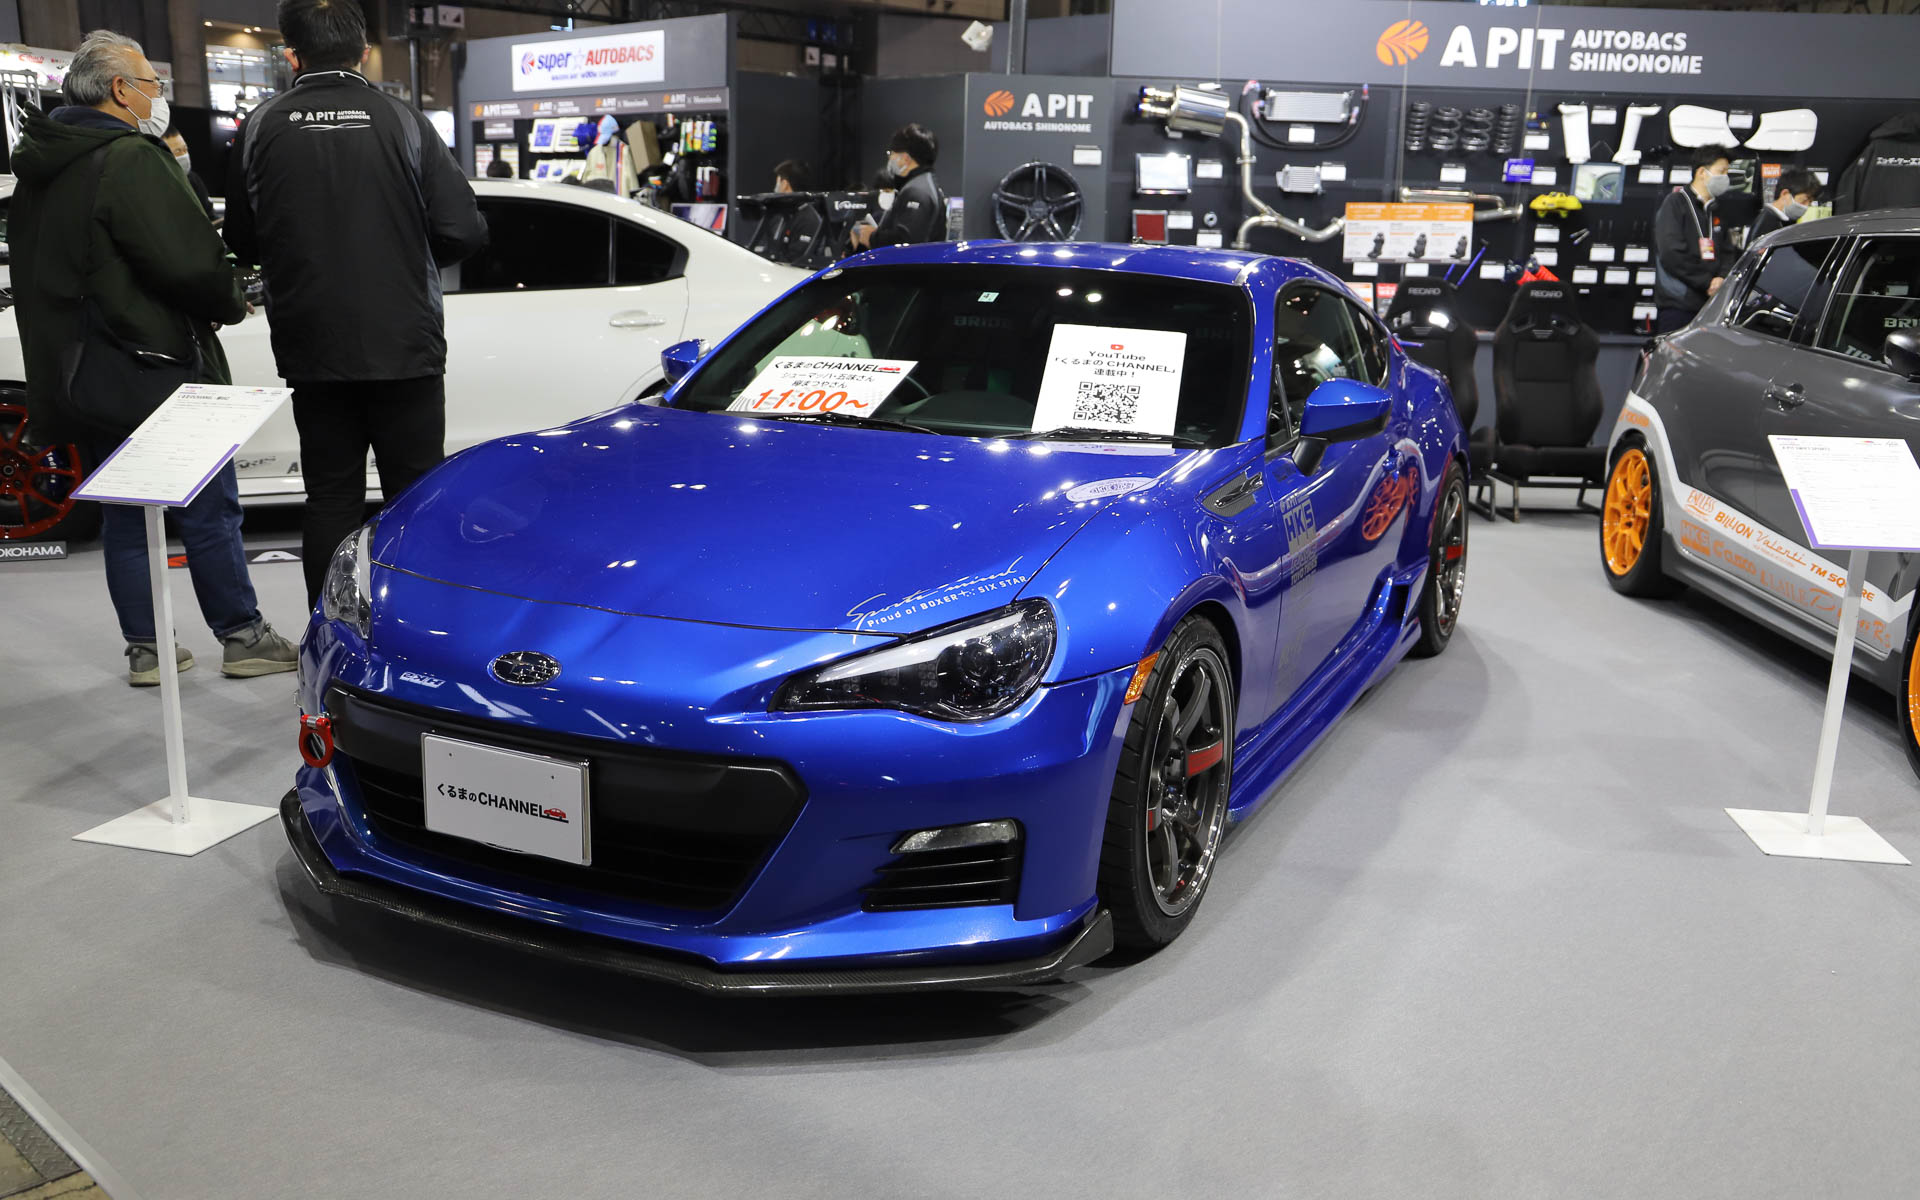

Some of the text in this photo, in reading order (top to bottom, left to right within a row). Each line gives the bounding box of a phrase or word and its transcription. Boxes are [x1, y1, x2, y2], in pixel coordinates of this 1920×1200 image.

[1440, 25, 1565, 70] A PIT
[1571, 29, 1688, 51] AUTOBACS
[585, 44, 656, 67] AUTOBACS
[1569, 52, 1703, 75] SHINONOME
[305, 111, 336, 121] A PIT
[1021, 93, 1094, 119] A PIT
[984, 121, 1093, 133] AUTOBACS SHINONOME
[1407, 286, 1441, 296] RECARO
[1530, 289, 1563, 299] RECARO
[1884, 317, 1920, 328] BRI
[1088, 350, 1146, 362] YouTube
[1284, 503, 1313, 542] HKS
[1714, 511, 1754, 539] BILLION
[1810, 563, 1828, 578] TM
[1827, 573, 1876, 602] SQRE
[867, 575, 1027, 628] Proud of BOXER SIX STAR
[437, 783, 546, 818] くるまのCHANNEL
